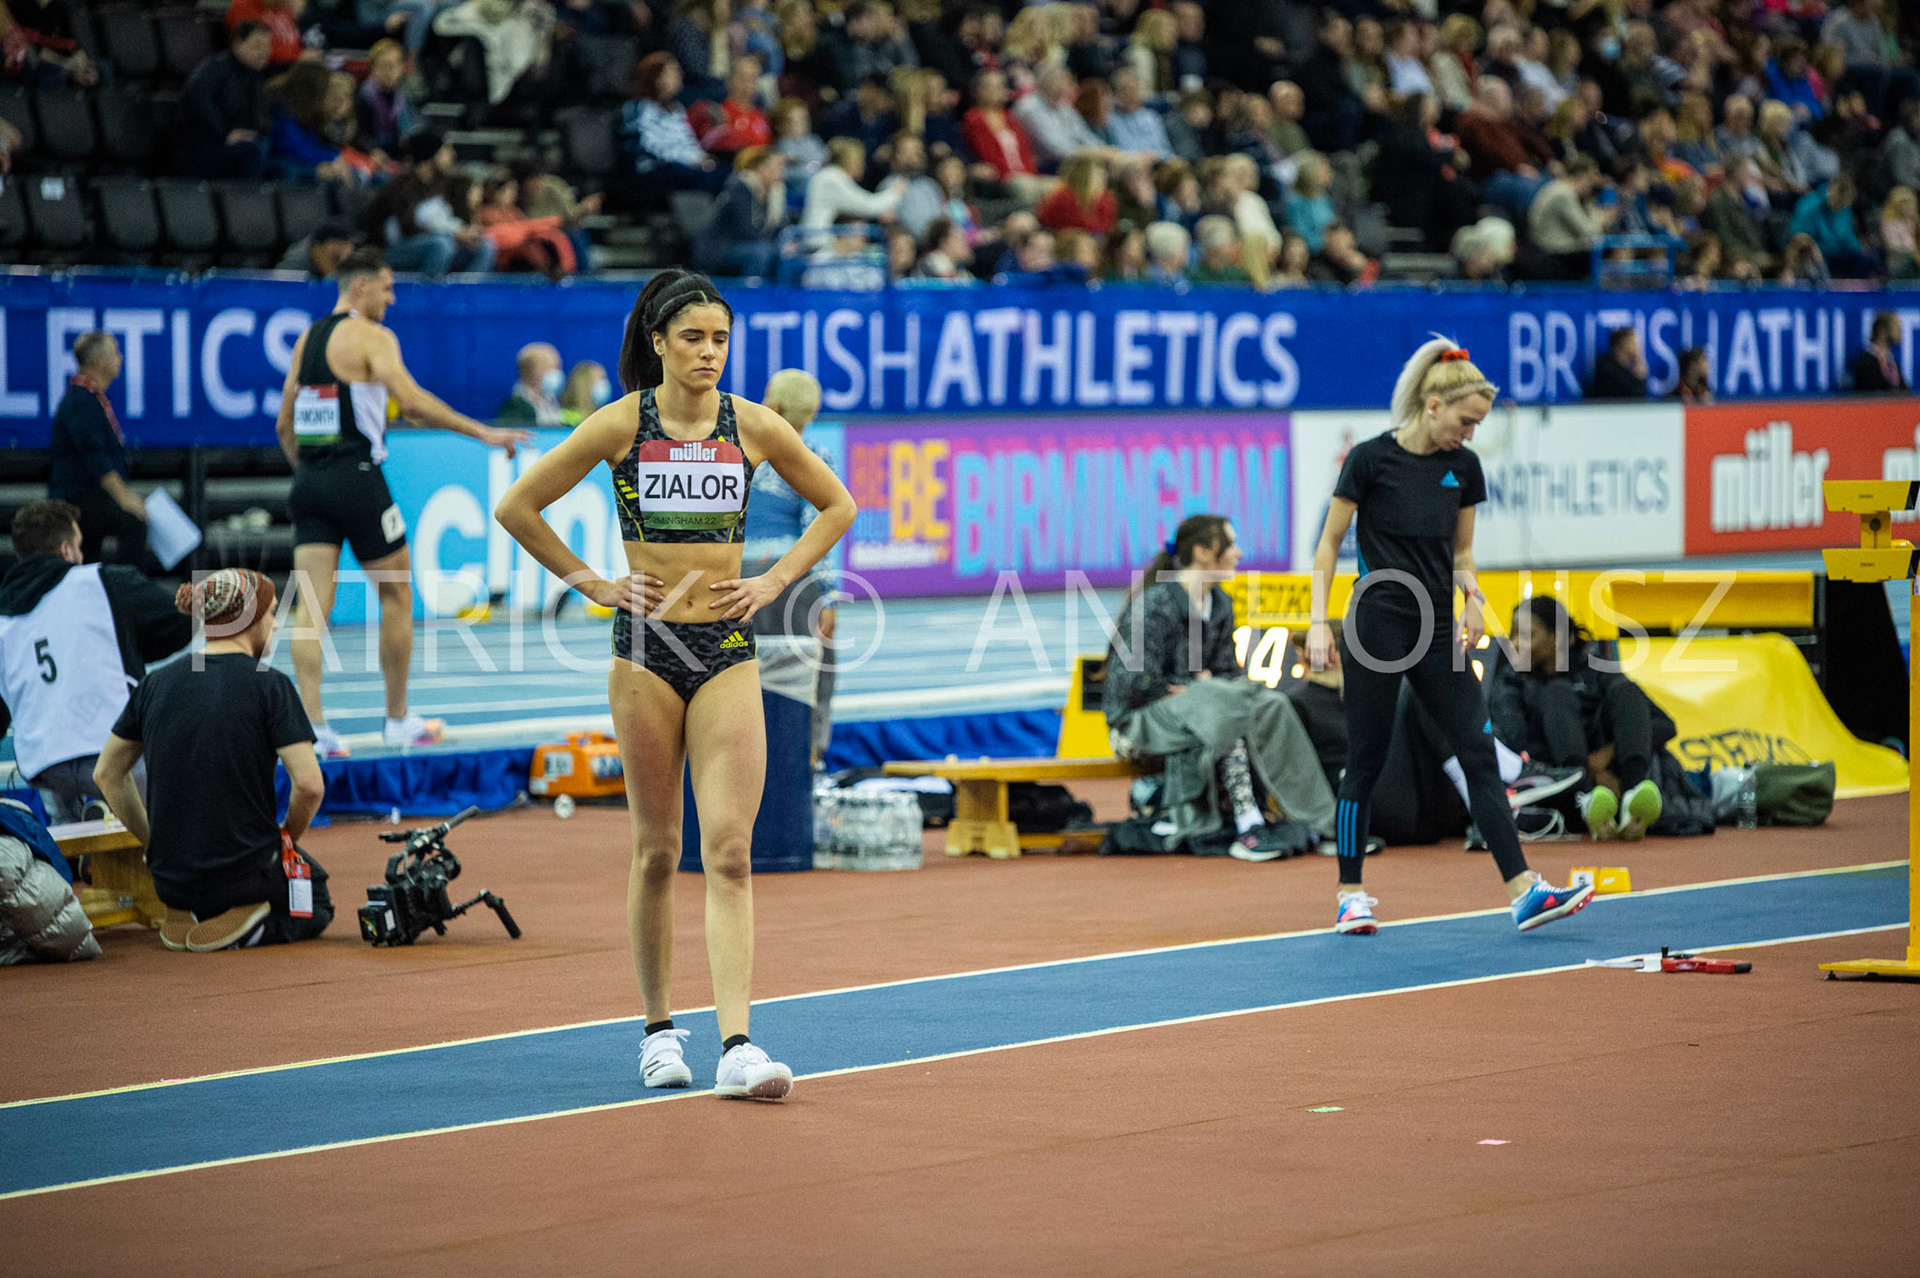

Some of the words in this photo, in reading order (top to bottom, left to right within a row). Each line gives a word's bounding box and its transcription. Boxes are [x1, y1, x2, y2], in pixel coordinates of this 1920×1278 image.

[669, 442, 718, 461] müller
[644, 473, 738, 500] ZIALOR
[1711, 420, 1830, 533] müller
[719, 640, 749, 649] adidas
[34, 637, 57, 684] 5
